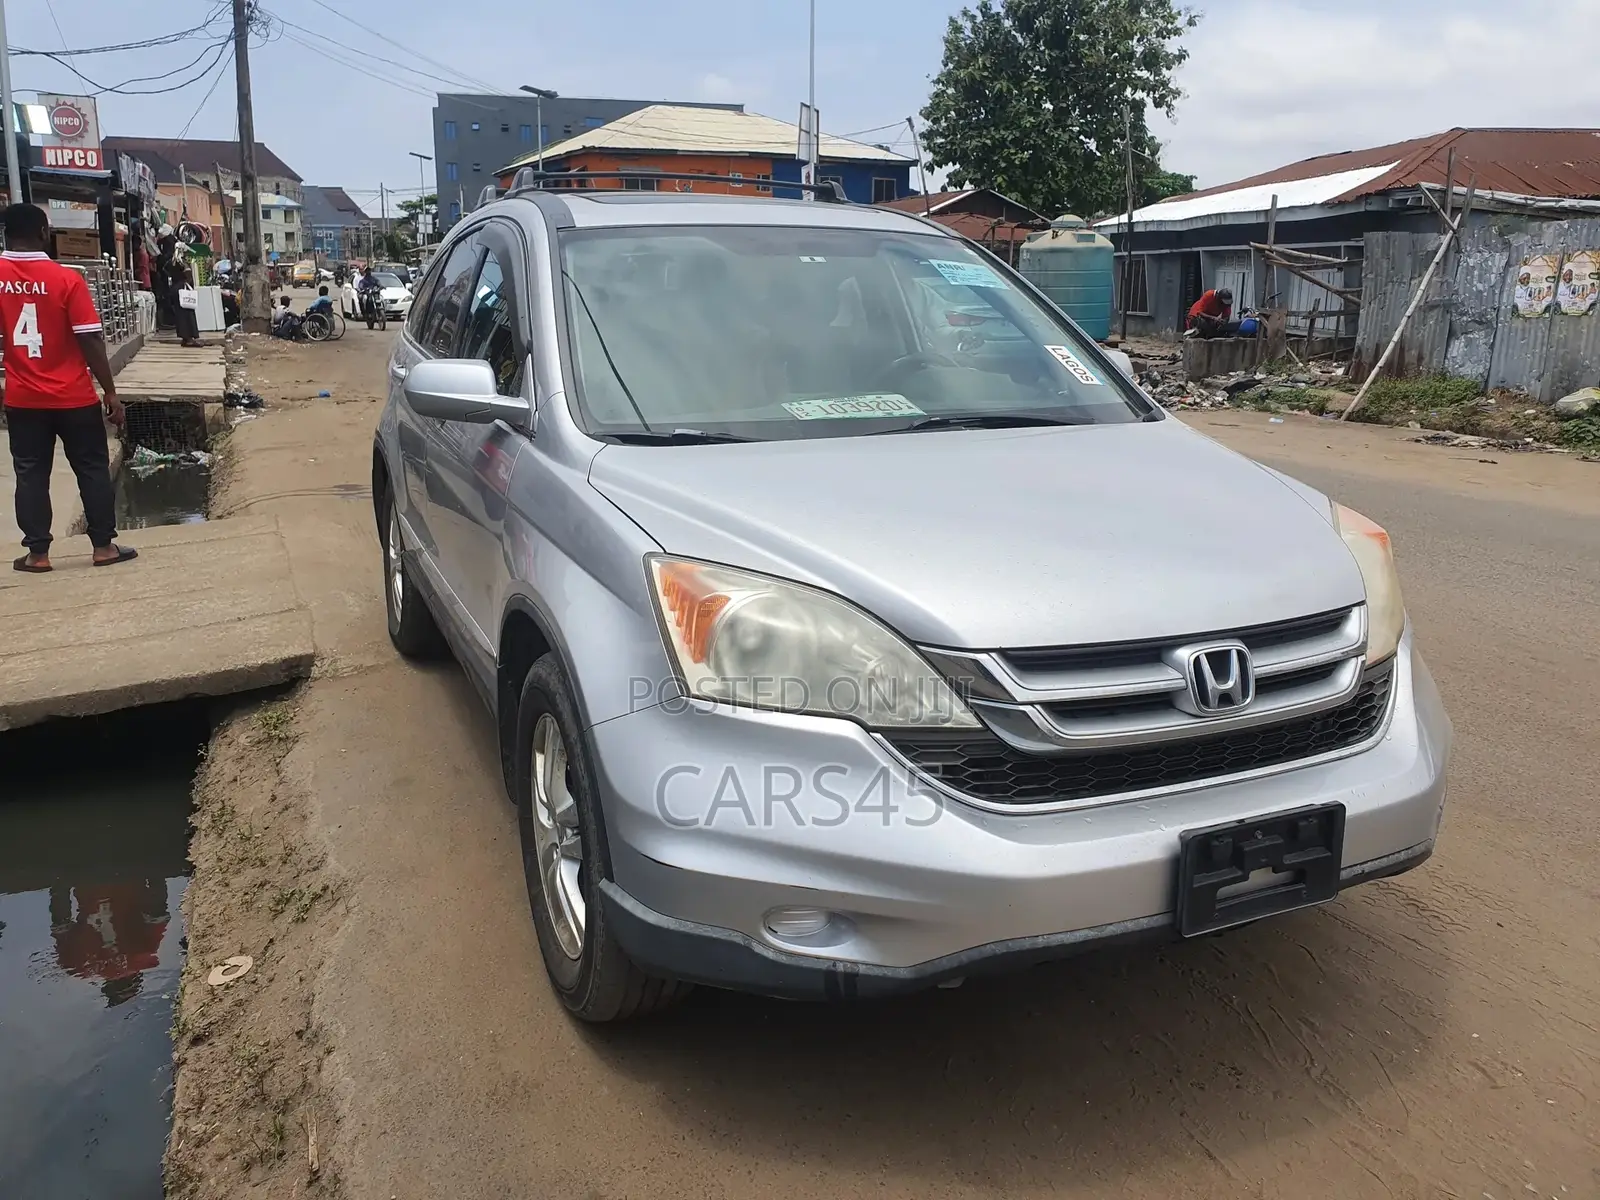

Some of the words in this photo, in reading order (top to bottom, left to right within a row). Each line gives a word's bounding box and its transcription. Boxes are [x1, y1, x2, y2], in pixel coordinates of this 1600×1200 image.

[54, 116, 80, 126] NIPCO
[45, 148, 98, 168] NIPCO
[0, 280, 48, 295] PASCAL
[13, 302, 43, 358] 4
[1050, 347, 1095, 382] LAGOS
